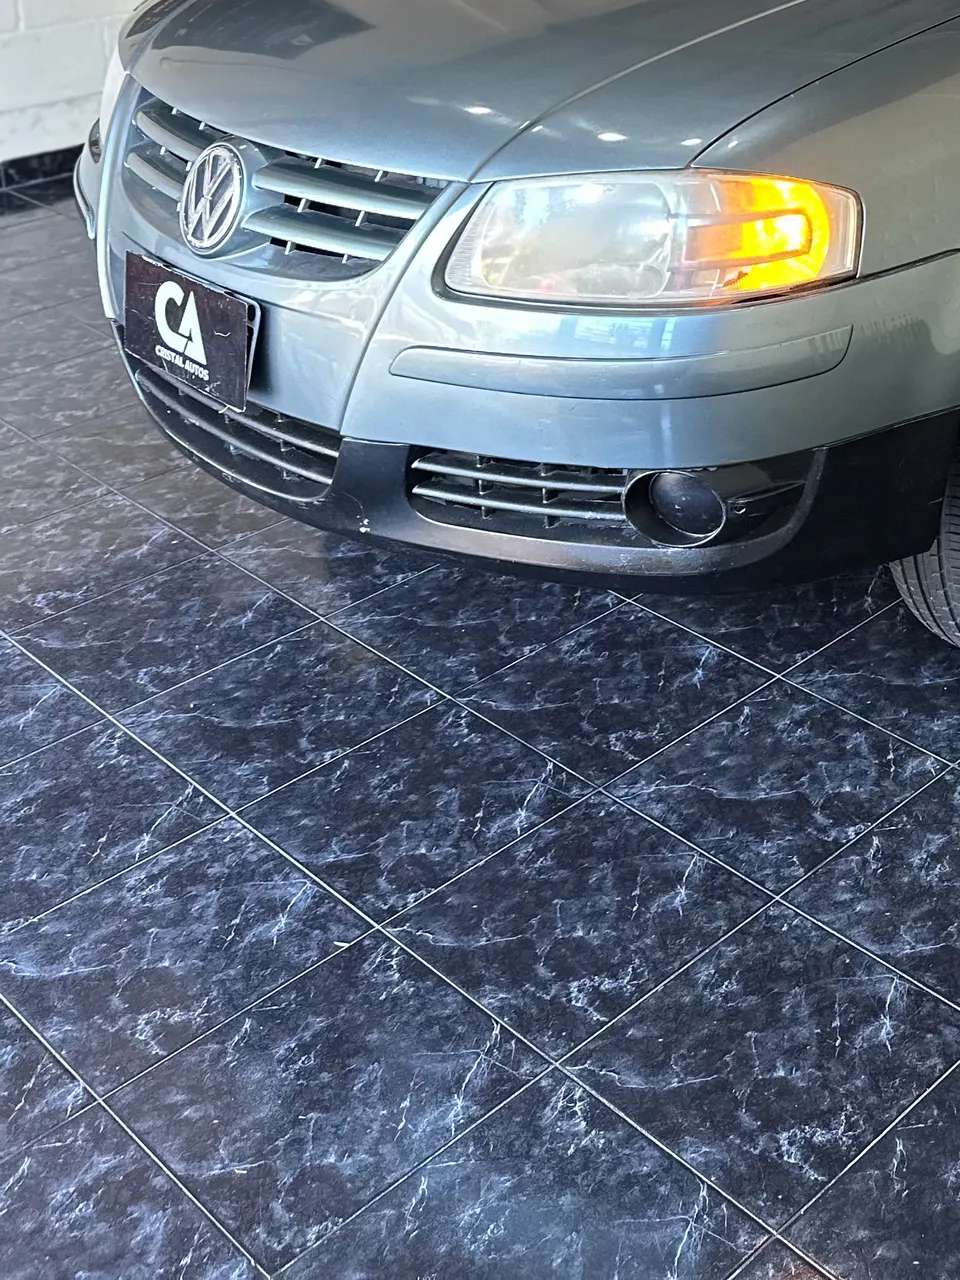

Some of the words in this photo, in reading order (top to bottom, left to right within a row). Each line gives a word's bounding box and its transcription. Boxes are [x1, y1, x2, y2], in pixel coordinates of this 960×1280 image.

[154, 280, 207, 366] CA
[155, 344, 184, 368] CRISTAL
[184, 359, 210, 381] AUTOS
